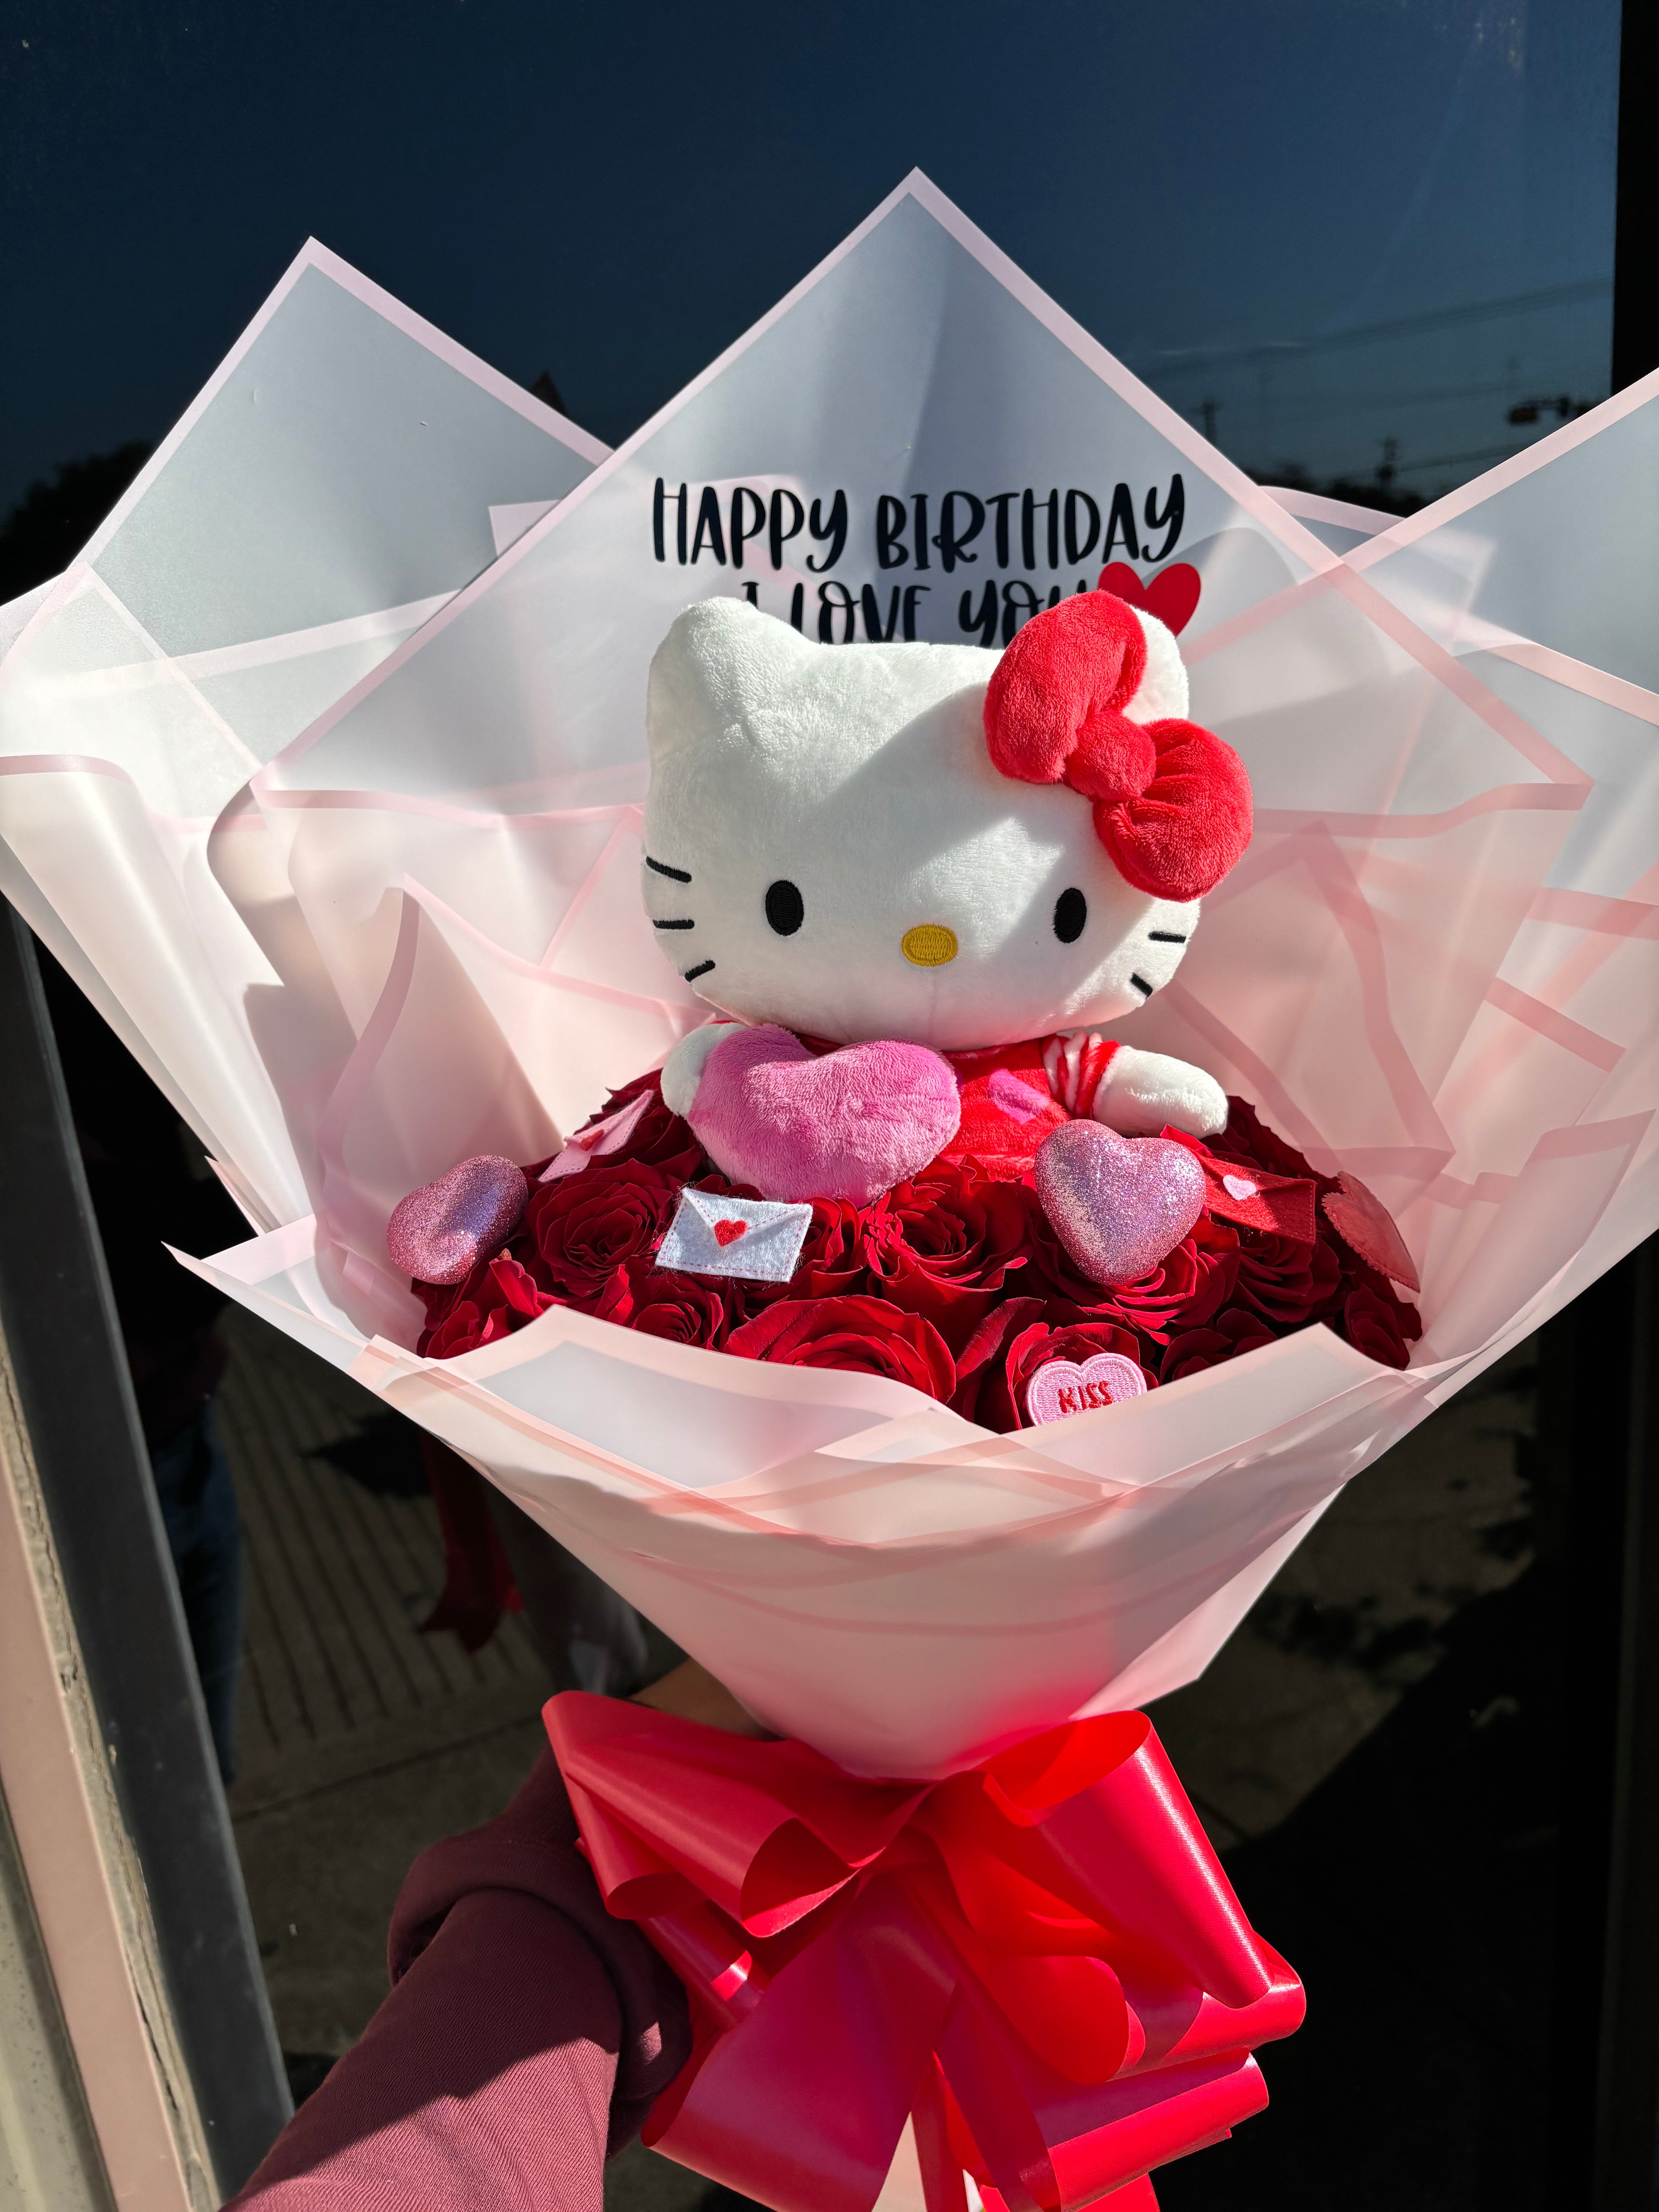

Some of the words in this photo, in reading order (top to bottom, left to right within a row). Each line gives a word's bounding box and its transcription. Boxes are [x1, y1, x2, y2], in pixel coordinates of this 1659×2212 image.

[653, 477, 848, 573] HAPPY
[875, 473, 1185, 573] BIRTHDAY
[1058, 1380, 1114, 1413] KISS
